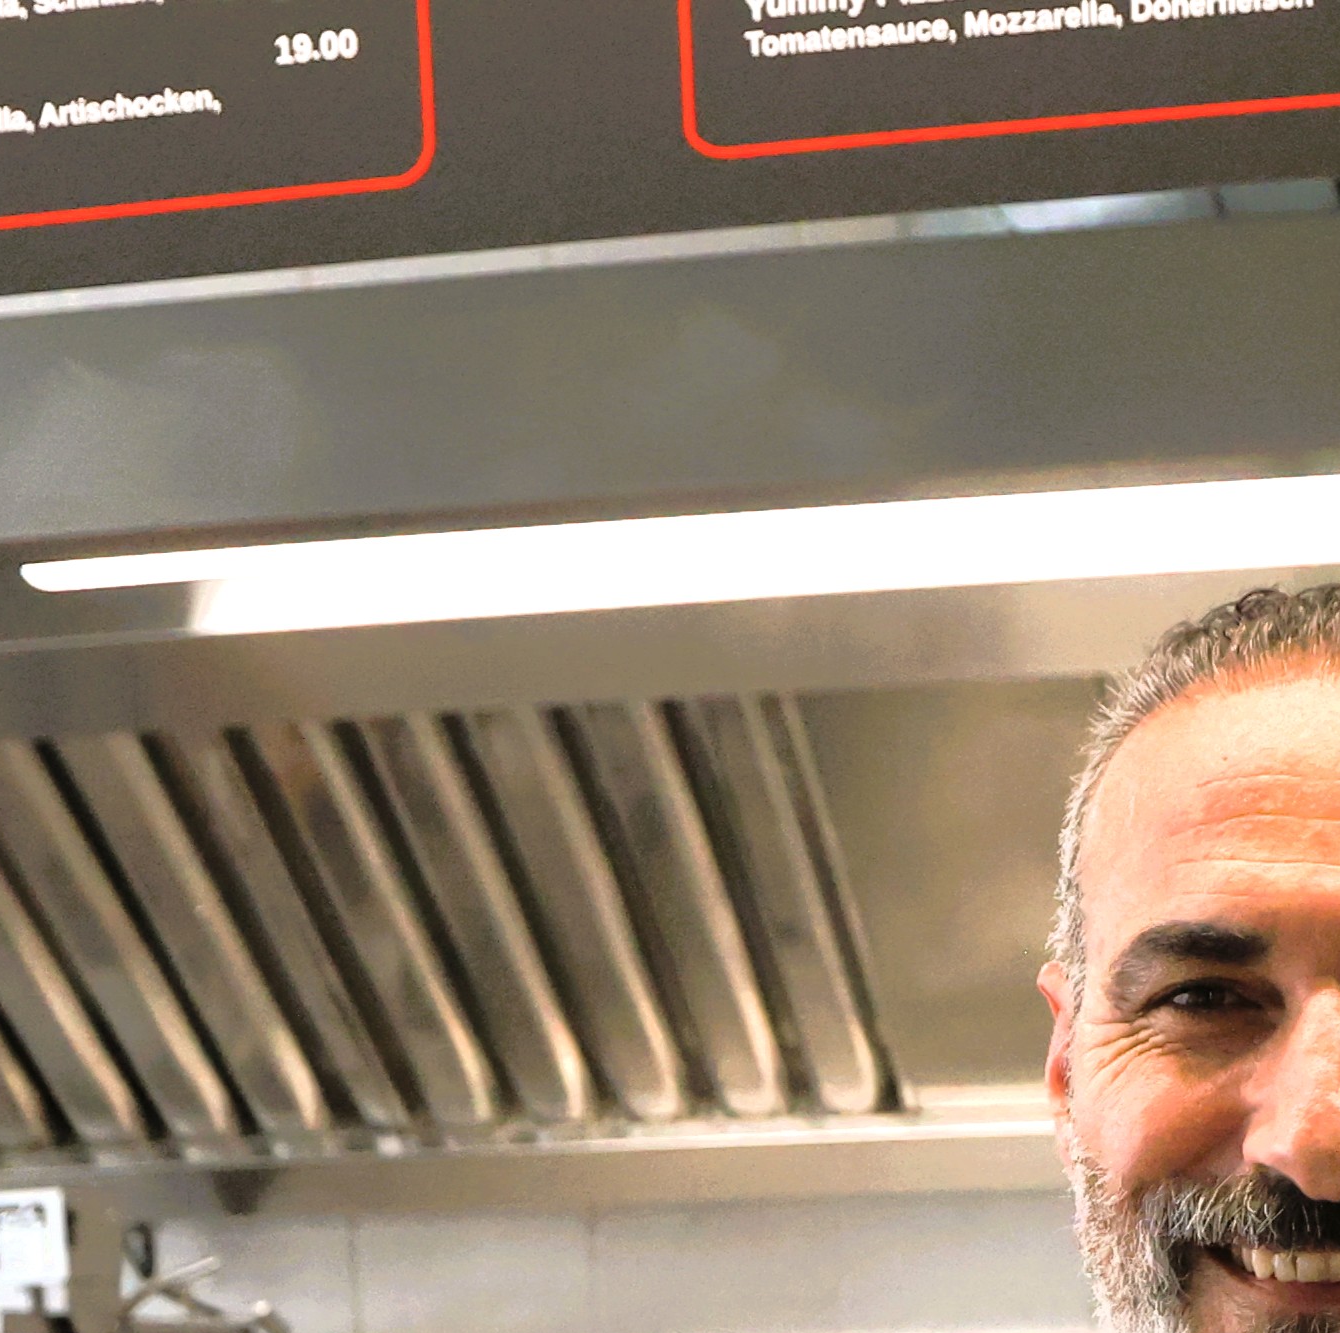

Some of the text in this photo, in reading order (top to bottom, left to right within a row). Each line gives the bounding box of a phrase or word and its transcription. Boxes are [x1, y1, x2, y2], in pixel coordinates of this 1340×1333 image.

[743, 18, 957, 58] Tomatensauce,
[963, 0, 1123, 38] Mozzarella,
[39, 87, 222, 128] Artischocken,
